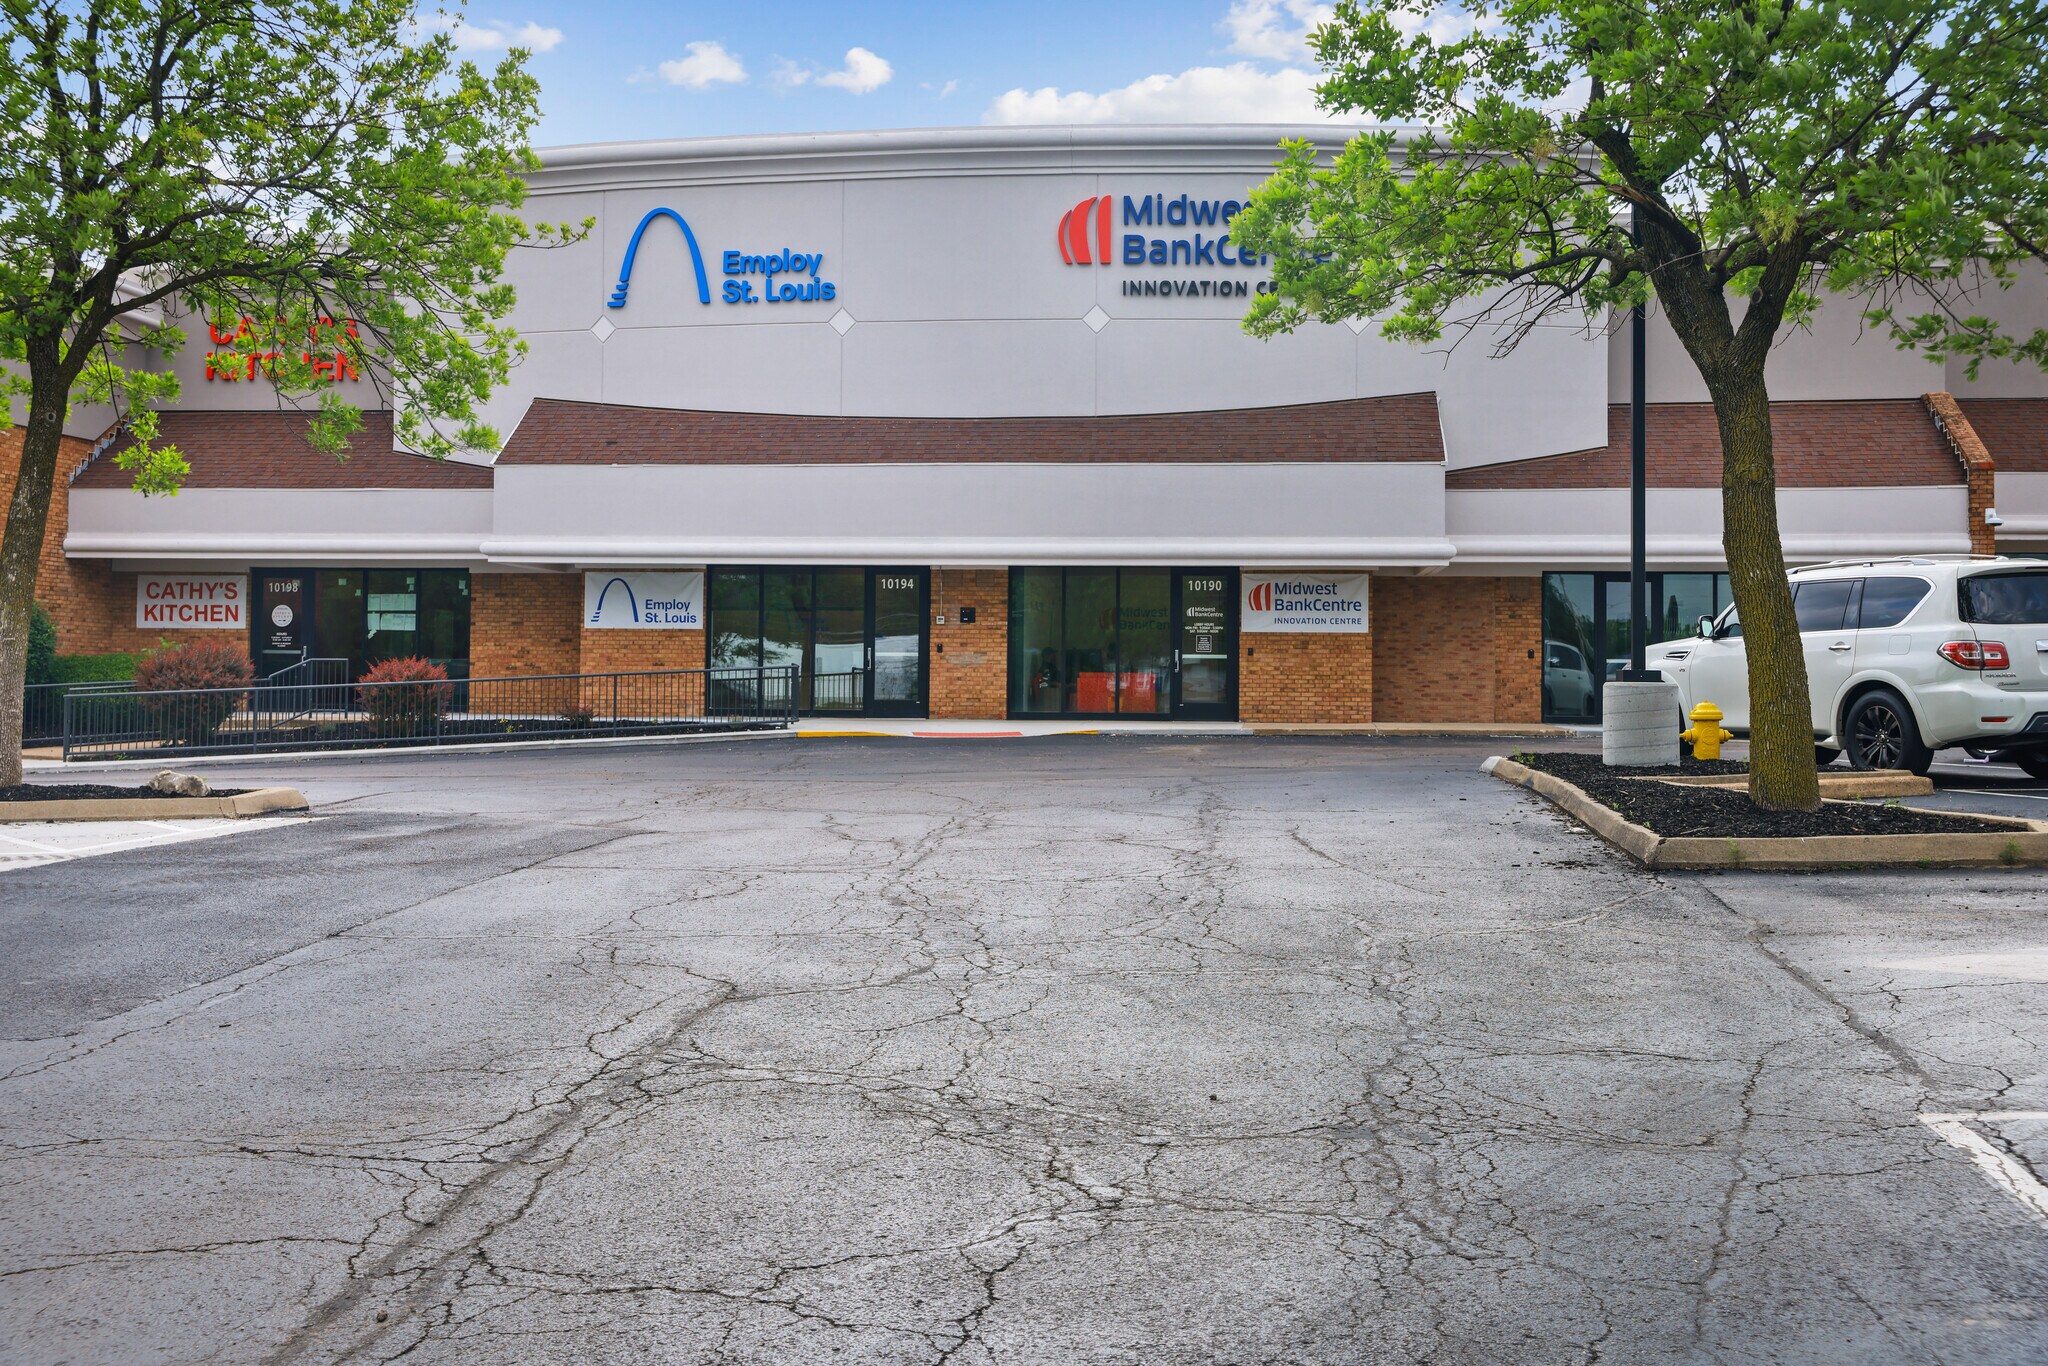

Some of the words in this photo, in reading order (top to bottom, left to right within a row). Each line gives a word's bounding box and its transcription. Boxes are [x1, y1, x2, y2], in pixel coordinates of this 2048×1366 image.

[1123, 193, 1254, 226] Midwe
[722, 248, 823, 278] Employ
[722, 279, 759, 304] St.
[765, 276, 837, 302] Louis
[1122, 280, 1248, 297] INNOVATION
[269, 582, 298, 593] 10198
[881, 578, 914, 589] 10194
[1188, 580, 1222, 591] 10190
[1274, 582, 1338, 595] Midwest
[146, 582, 238, 600] CATHY'S
[645, 599, 690, 612] Employ
[1274, 598, 1362, 612] BankCentre
[144, 604, 239, 622] KITCHEN
[645, 613, 662, 623] St.
[665, 612, 697, 623] Louis
[1274, 617, 1327, 625] INNOVATION
[1329, 617, 1362, 625] CENTRE
